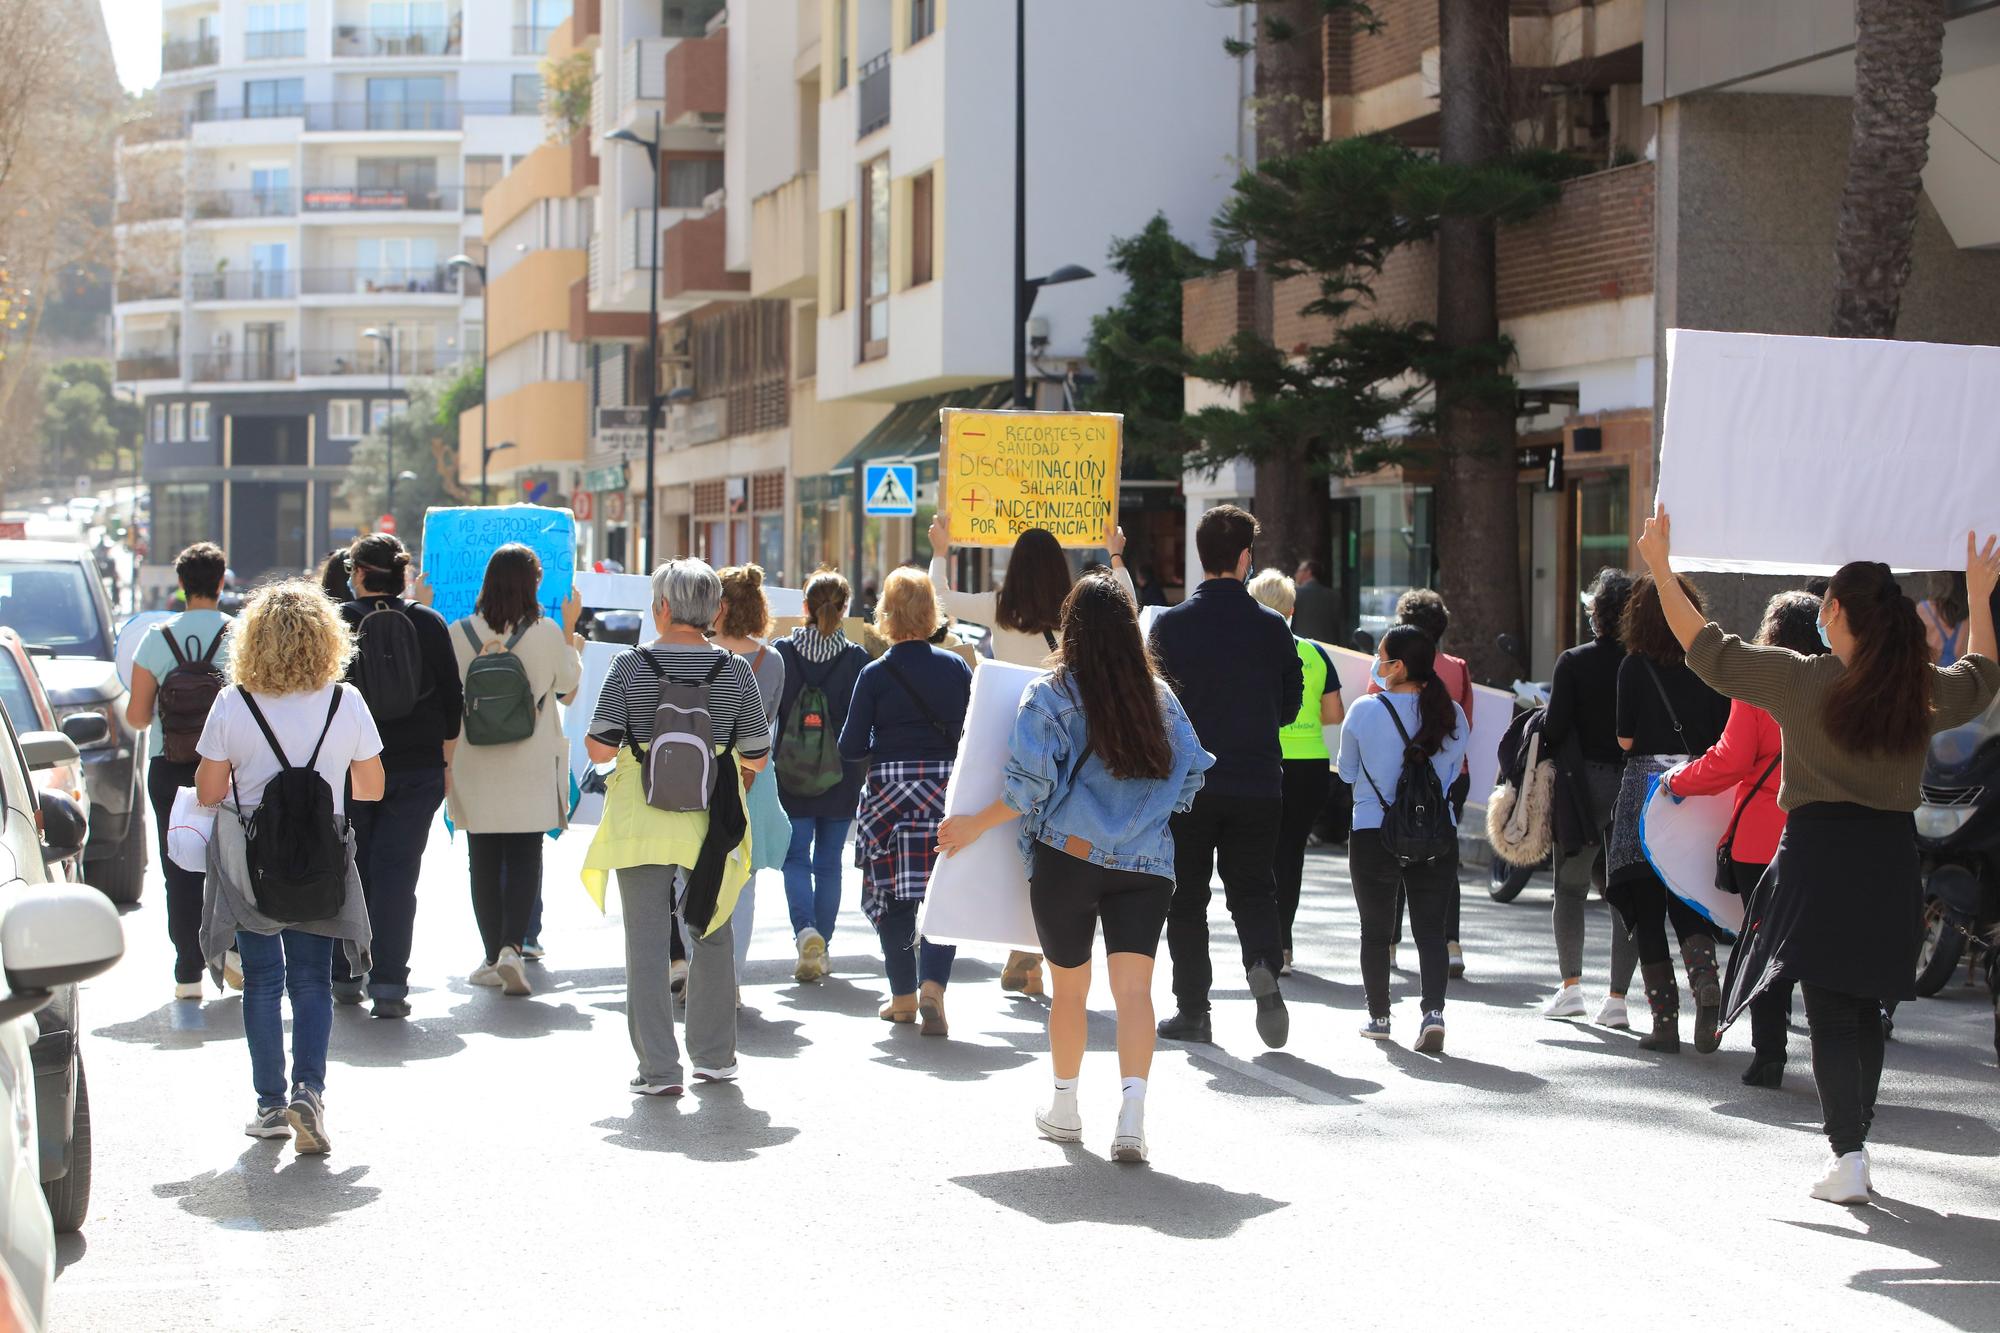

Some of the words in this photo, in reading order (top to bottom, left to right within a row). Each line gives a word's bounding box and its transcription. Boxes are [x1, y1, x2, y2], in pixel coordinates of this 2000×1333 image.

[1005, 425, 1081, 442] RECORTES
[1085, 426, 1106, 441] EN
[996, 441, 1060, 456] SANIDAD
[1074, 442, 1085, 455] Y
[959, 453, 1106, 480] DISCRIMINACIÓN
[971, 518, 997, 535] POR
